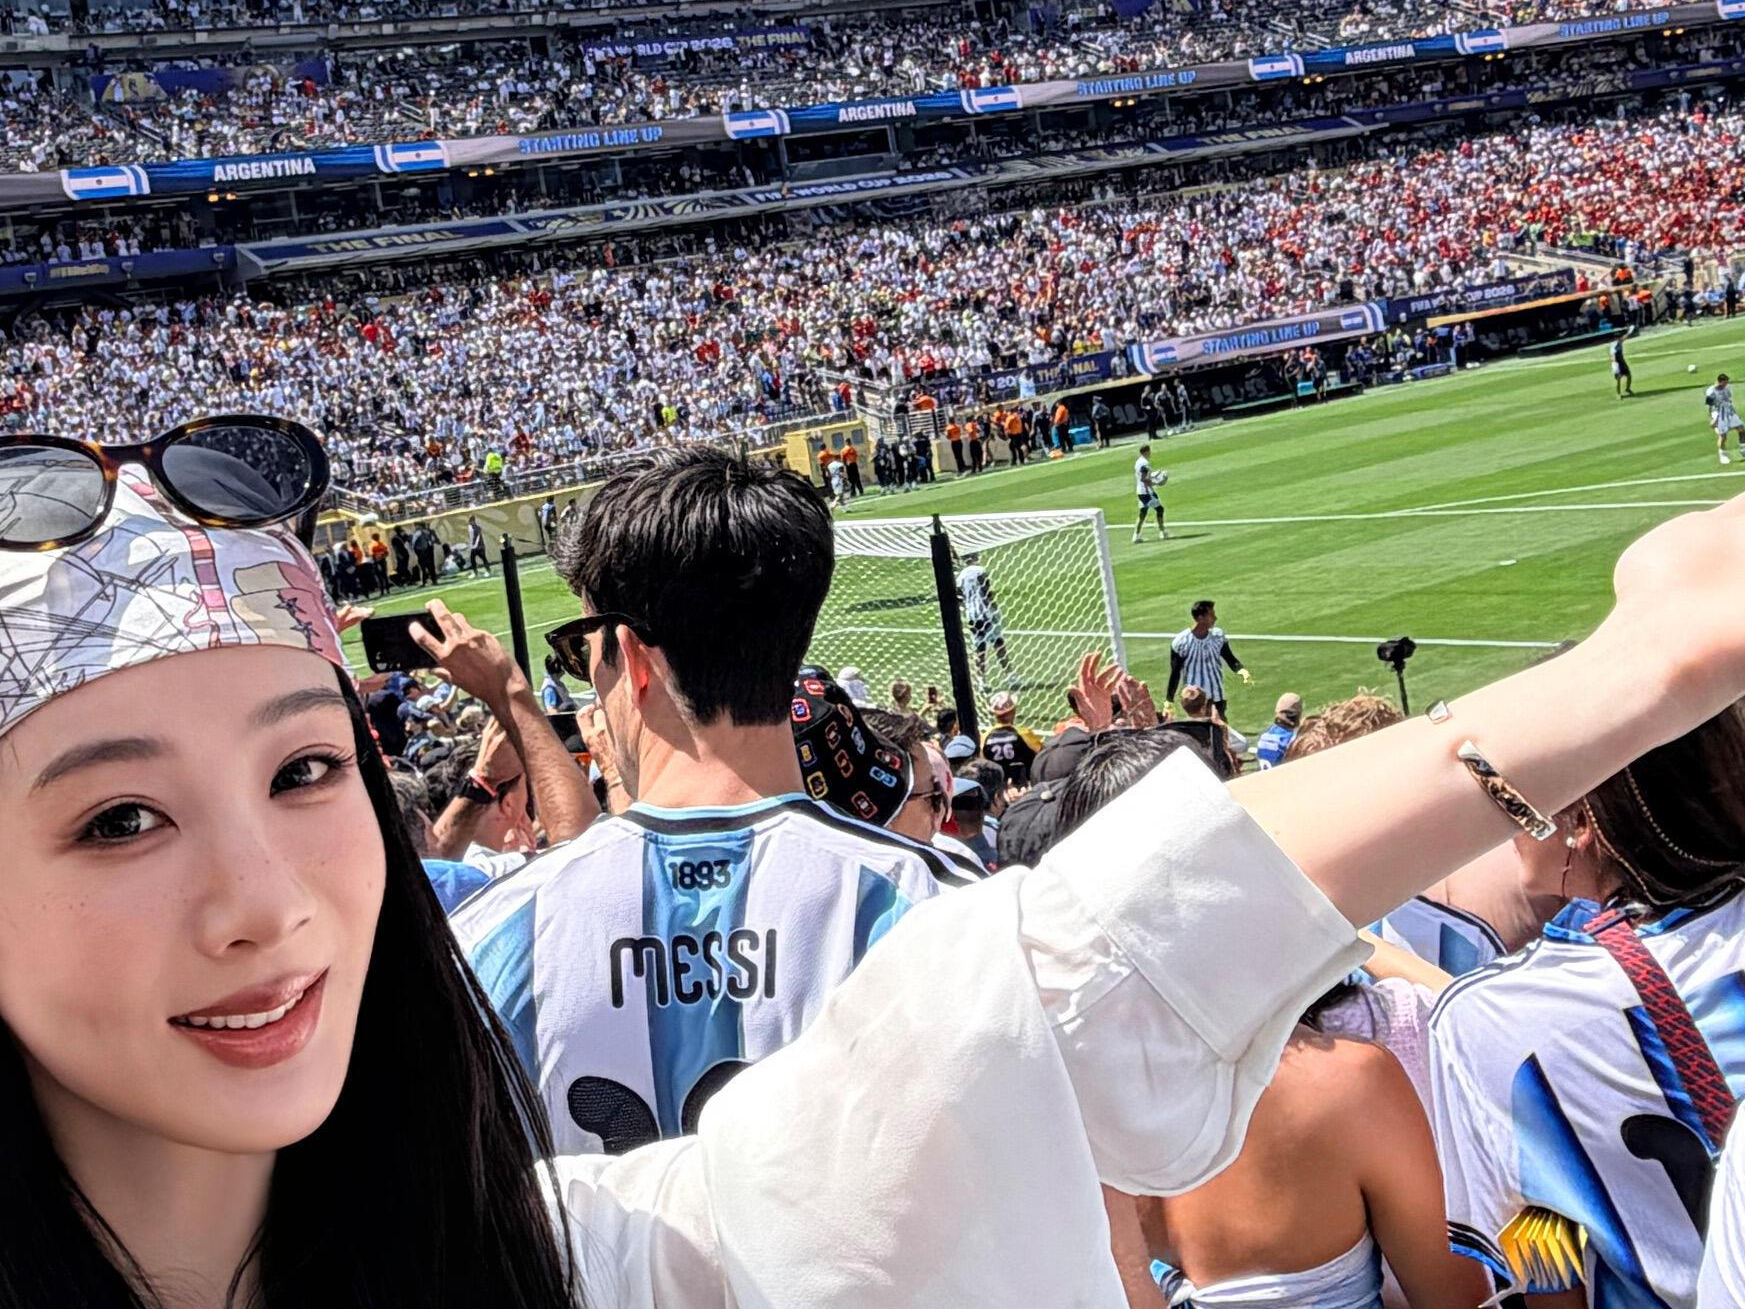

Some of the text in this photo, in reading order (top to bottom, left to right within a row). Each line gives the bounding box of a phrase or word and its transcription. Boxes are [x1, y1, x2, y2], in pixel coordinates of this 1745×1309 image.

[1559, 12, 1669, 37] STARTING LINE UP
[735, 34, 766, 47] THE
[1345, 44, 1415, 65] ARGENTINA
[1178, 71, 1196, 85] UP
[838, 101, 916, 122] ARGENTINA
[519, 127, 662, 154] STARTING LINE UP
[214, 158, 316, 181] ARGENTINA
[858, 179, 891, 189] CUP
[307, 230, 464, 254] THE FINAL
[1272, 325, 1301, 344] LINE
[1302, 321, 1320, 339] UP
[990, 744, 1015, 761] 26
[668, 860, 732, 891] 1893
[609, 927, 777, 1009] MESSI
